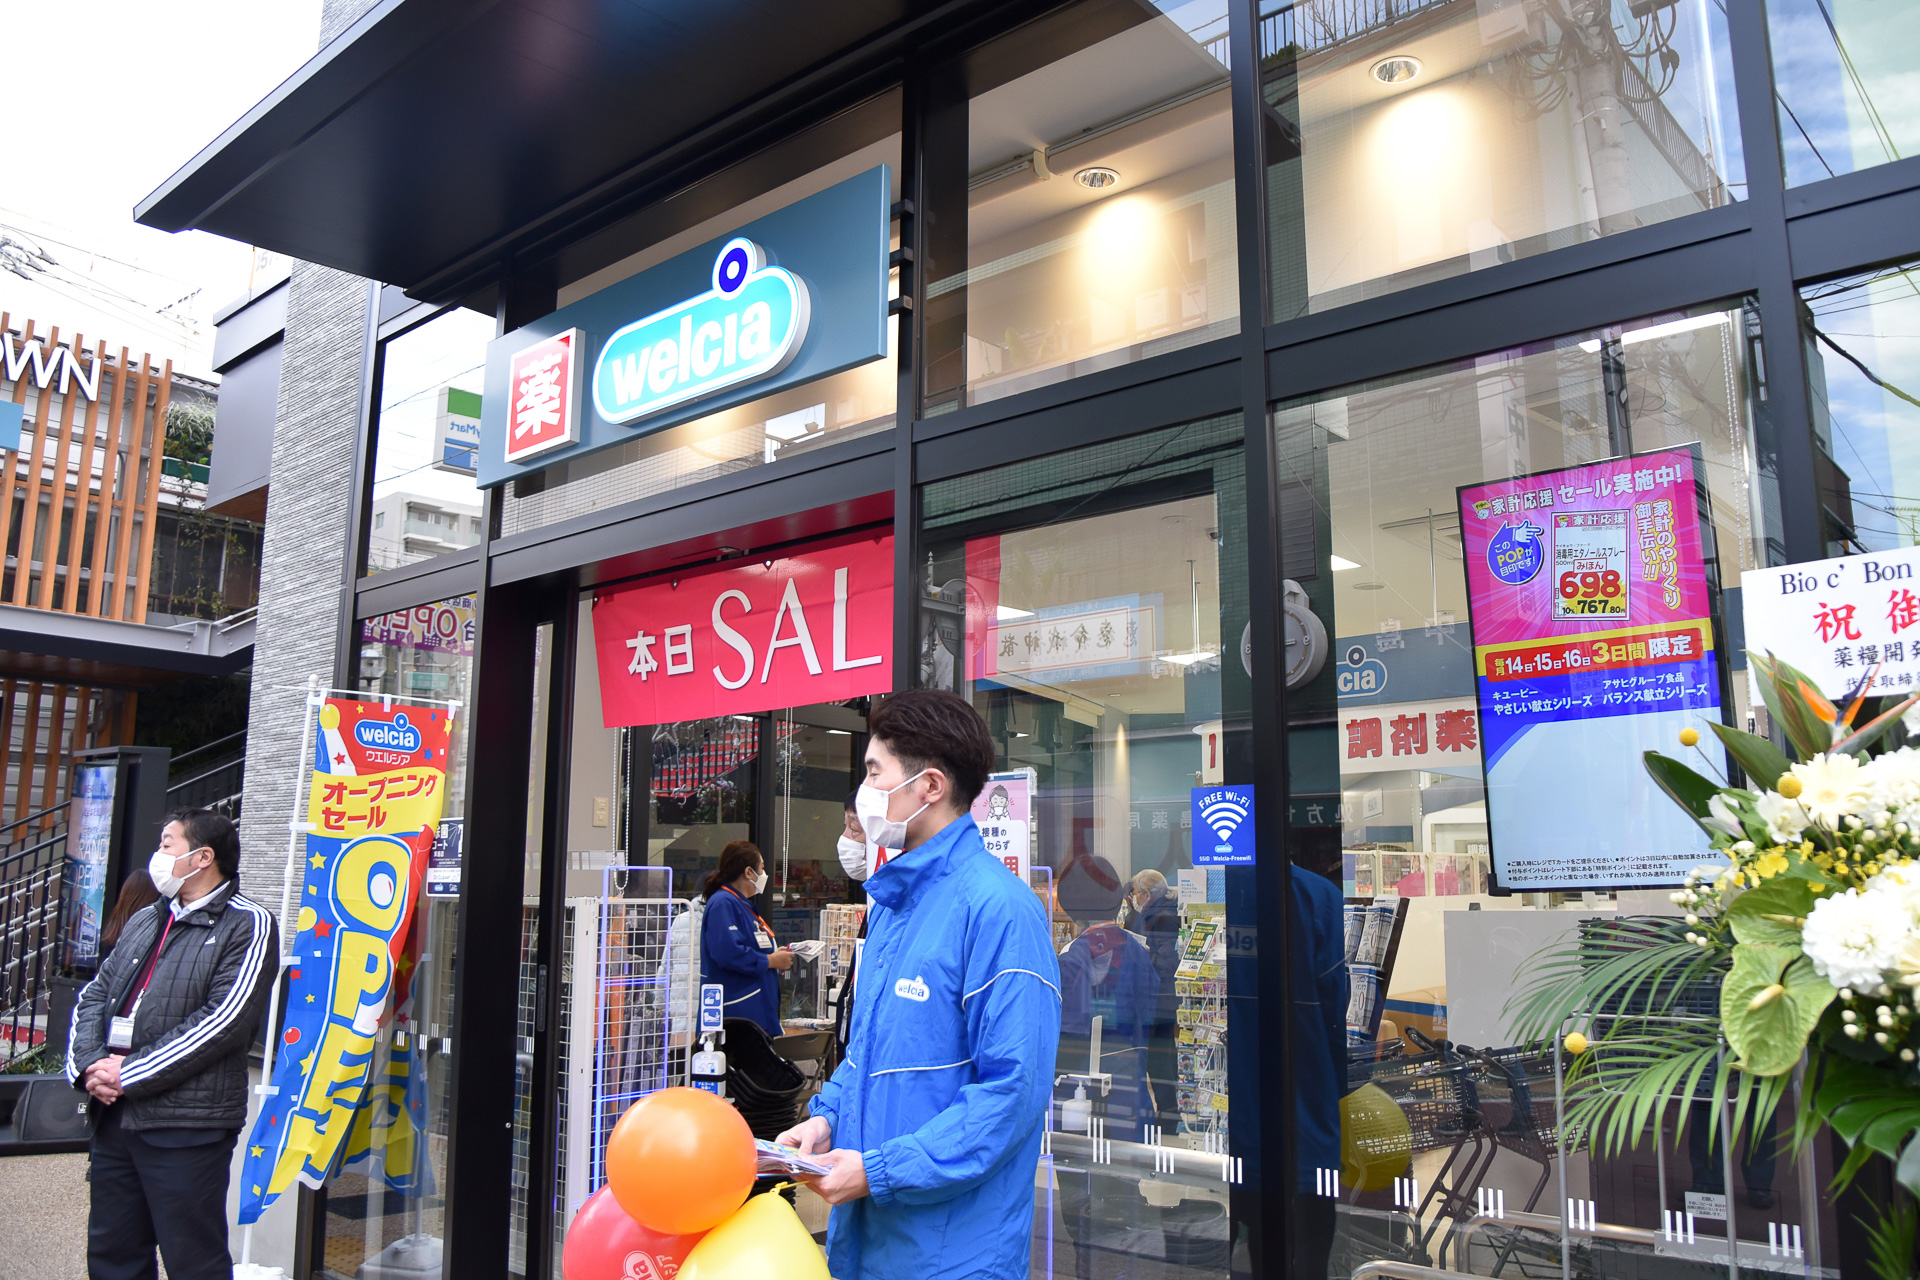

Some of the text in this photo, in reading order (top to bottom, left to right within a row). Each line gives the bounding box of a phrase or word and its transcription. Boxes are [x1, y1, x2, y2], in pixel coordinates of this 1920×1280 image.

[611, 299, 771, 405] welcia
[0, 332, 101, 402] WN
[515, 351, 563, 440] 薬
[1491, 487, 1554, 516] 家計応援
[1495, 541, 1511, 553] この
[1651, 500, 1678, 608] 家計のやりくり
[1576, 561, 1604, 570] みほん
[1780, 572, 1818, 595] Bio
[1863, 561, 1913, 584] Bon
[1812, 602, 1862, 644] 祝
[626, 624, 695, 681] 本日
[1648, 635, 1693, 659] 限定
[1603, 672, 1685, 690] アサヒグループ食品
[1603, 682, 1708, 705] バランス献立シリーズ
[1494, 694, 1593, 716] やさしい献立シリーズ
[360, 725, 415, 748] welcia
[1346, 709, 1477, 759] 調剤薬
[366, 750, 411, 766] ウエルシア
[322, 774, 438, 807] オープニング
[1198, 790, 1251, 809] FREE Wi-Fi
[321, 805, 387, 833] セール
[982, 827, 1007, 838] 接種の
